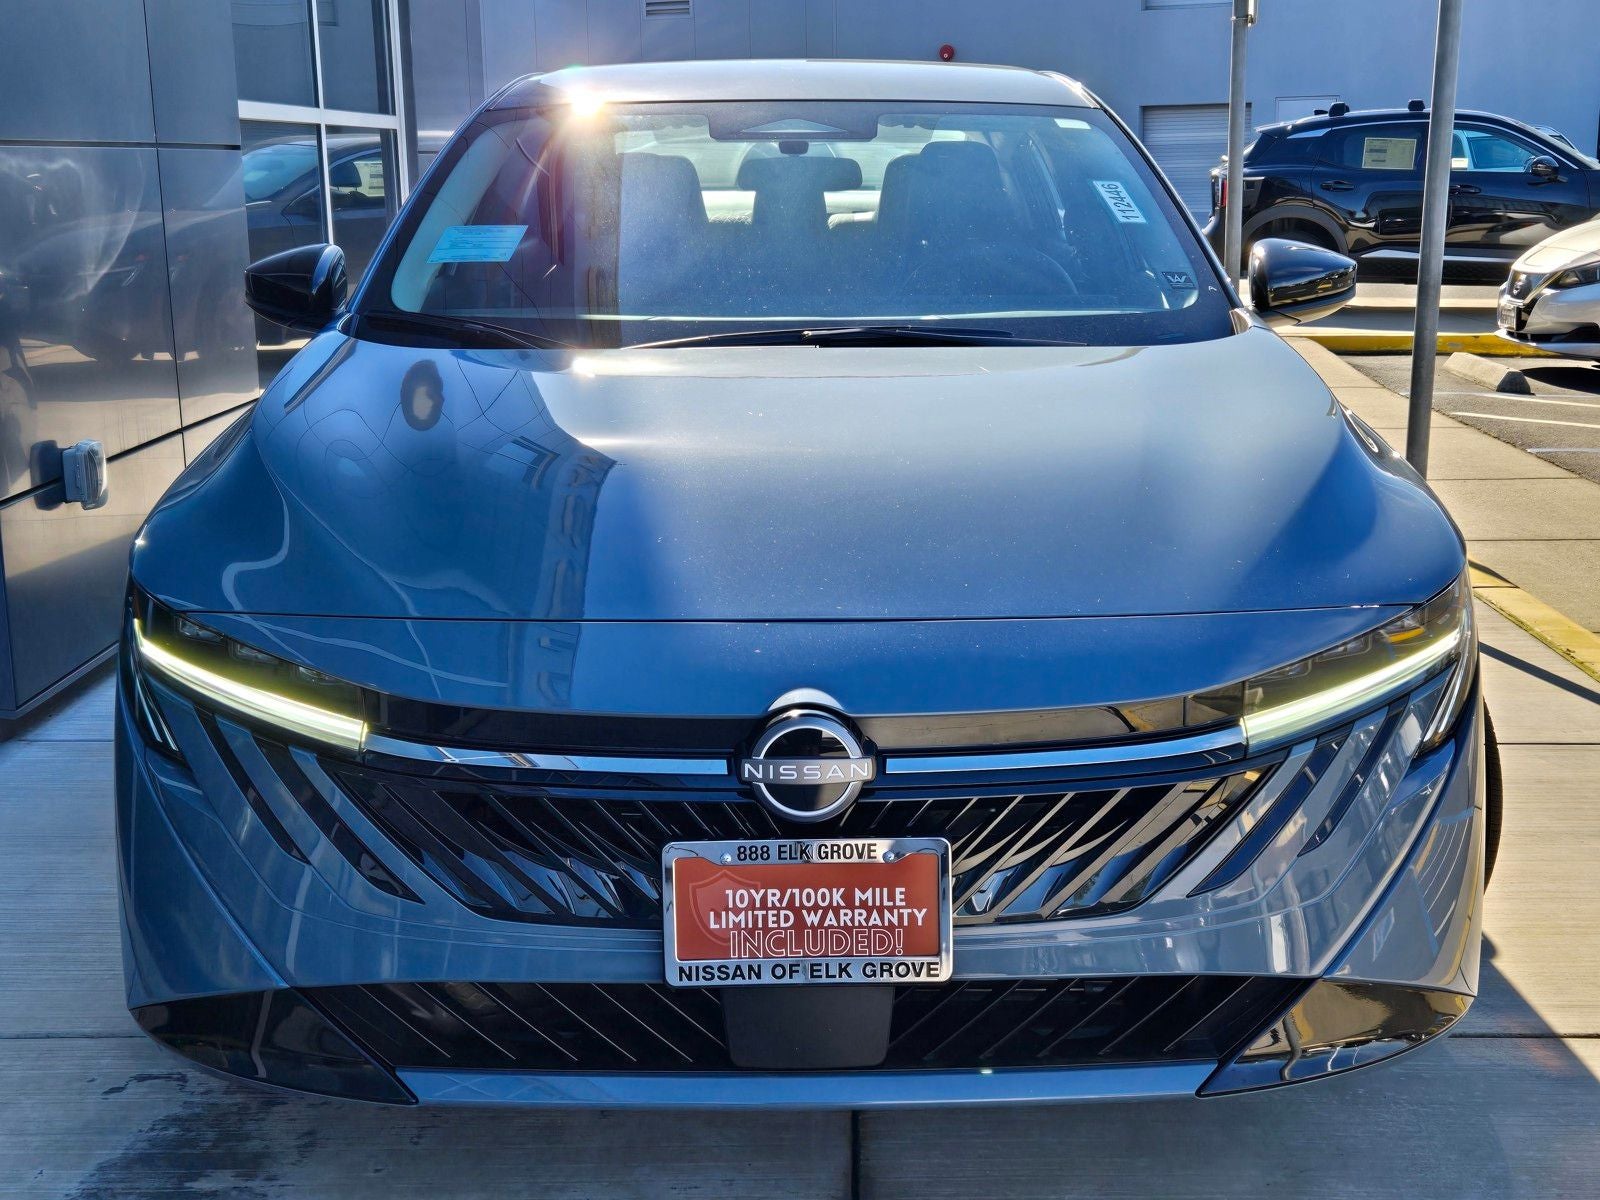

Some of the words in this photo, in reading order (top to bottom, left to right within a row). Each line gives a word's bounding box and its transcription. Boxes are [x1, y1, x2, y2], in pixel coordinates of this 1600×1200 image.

[744, 763, 869, 780] NISSAN
[736, 845, 771, 862] 888
[777, 843, 813, 861] ELK
[817, 843, 877, 861] GROVE
[725, 887, 846, 908] 10YR/100K
[854, 887, 906, 907] MILE
[709, 910, 795, 929] LIMITED
[801, 908, 928, 927] WARRANTY
[729, 928, 904, 958] INCLUDED!
[678, 964, 762, 982] NISSAN
[771, 963, 801, 980] OF
[809, 962, 853, 979] ELK
[861, 961, 940, 979] GROVE
